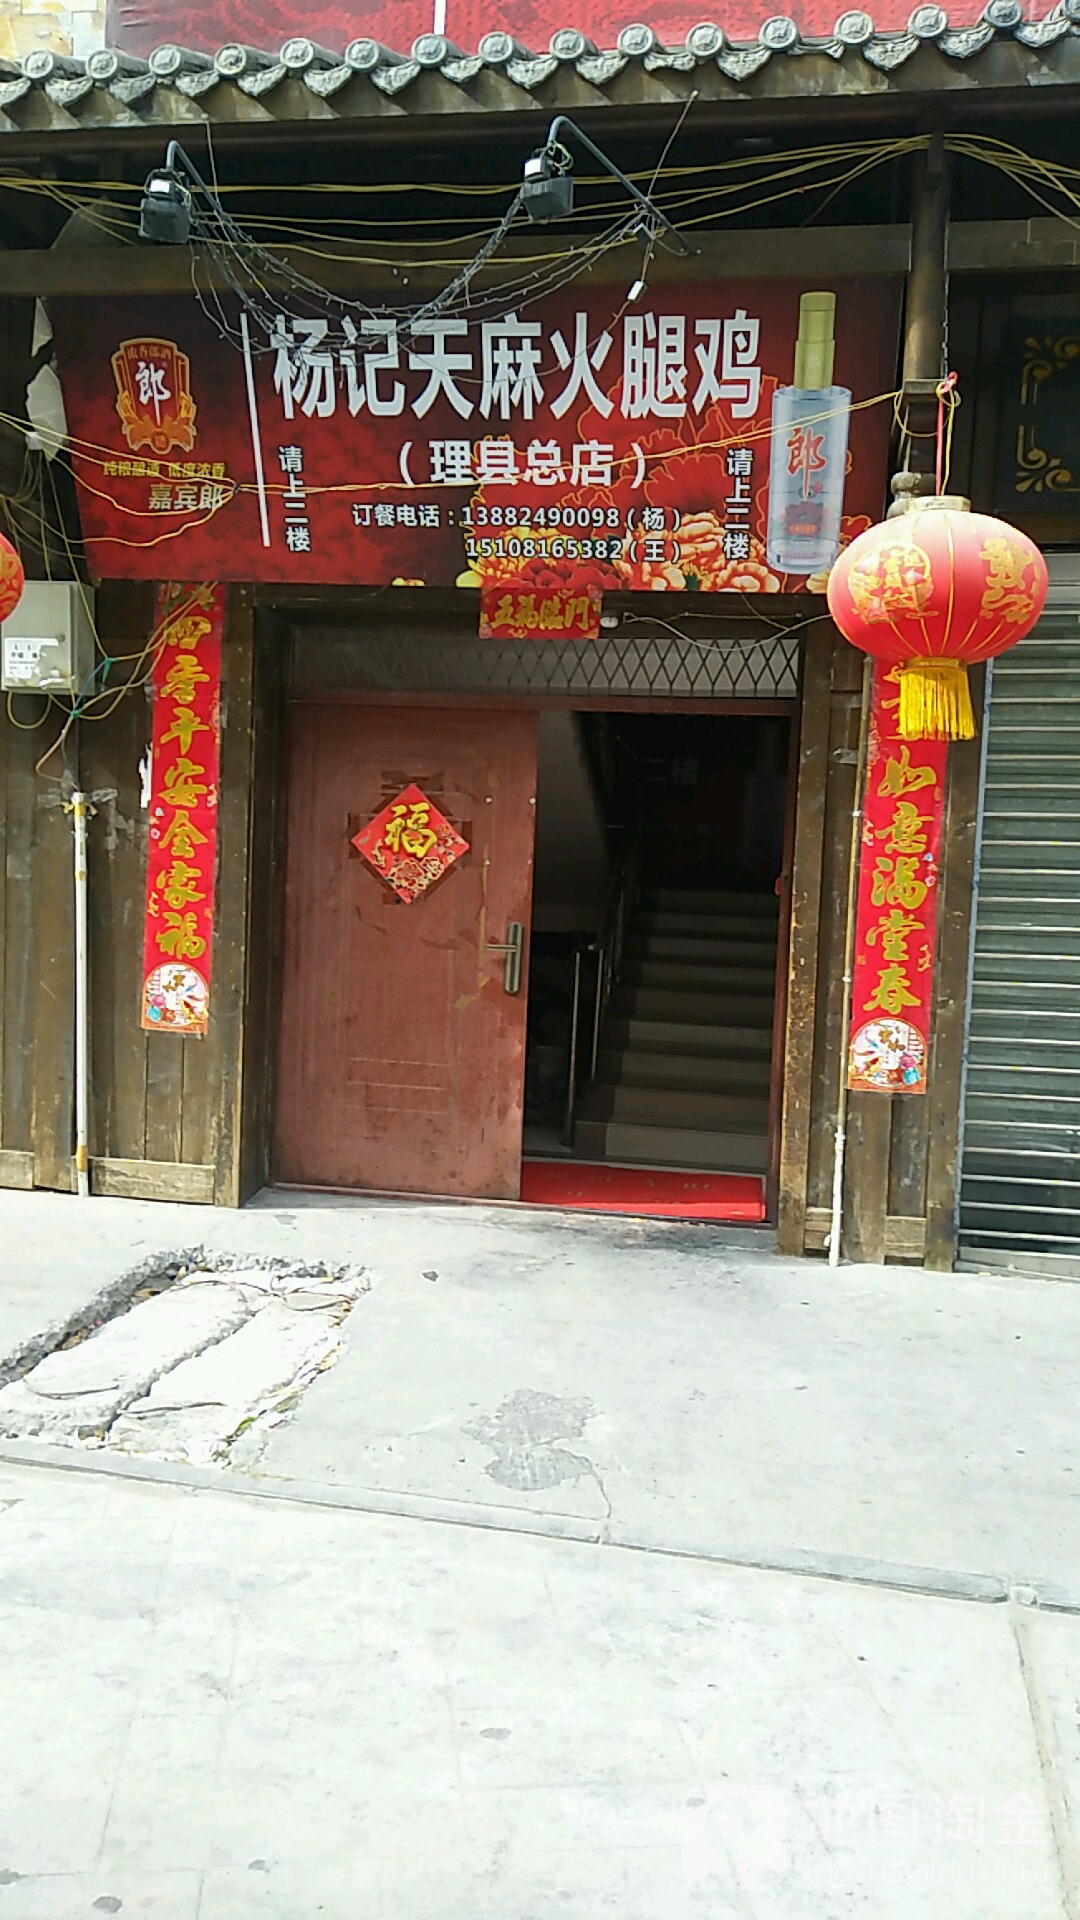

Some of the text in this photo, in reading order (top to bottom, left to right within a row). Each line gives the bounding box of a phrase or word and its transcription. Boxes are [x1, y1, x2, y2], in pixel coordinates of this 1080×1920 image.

[136, 361, 171, 427] 郎
[270, 309, 761, 420] 杨记天麻火腿鸡
[149, 484, 226, 511] 嘉宾郎
[279, 446, 310, 552] 请上二楼
[724, 448, 753, 559] 请上二楼
[787, 427, 825, 500] 郎
[466, 537, 681, 562] 15108165382（王）
[156, 616, 212, 959] 四季平安全家福
[385, 802, 438, 858] 福
[863, 663, 937, 1015] 如意满堂春
